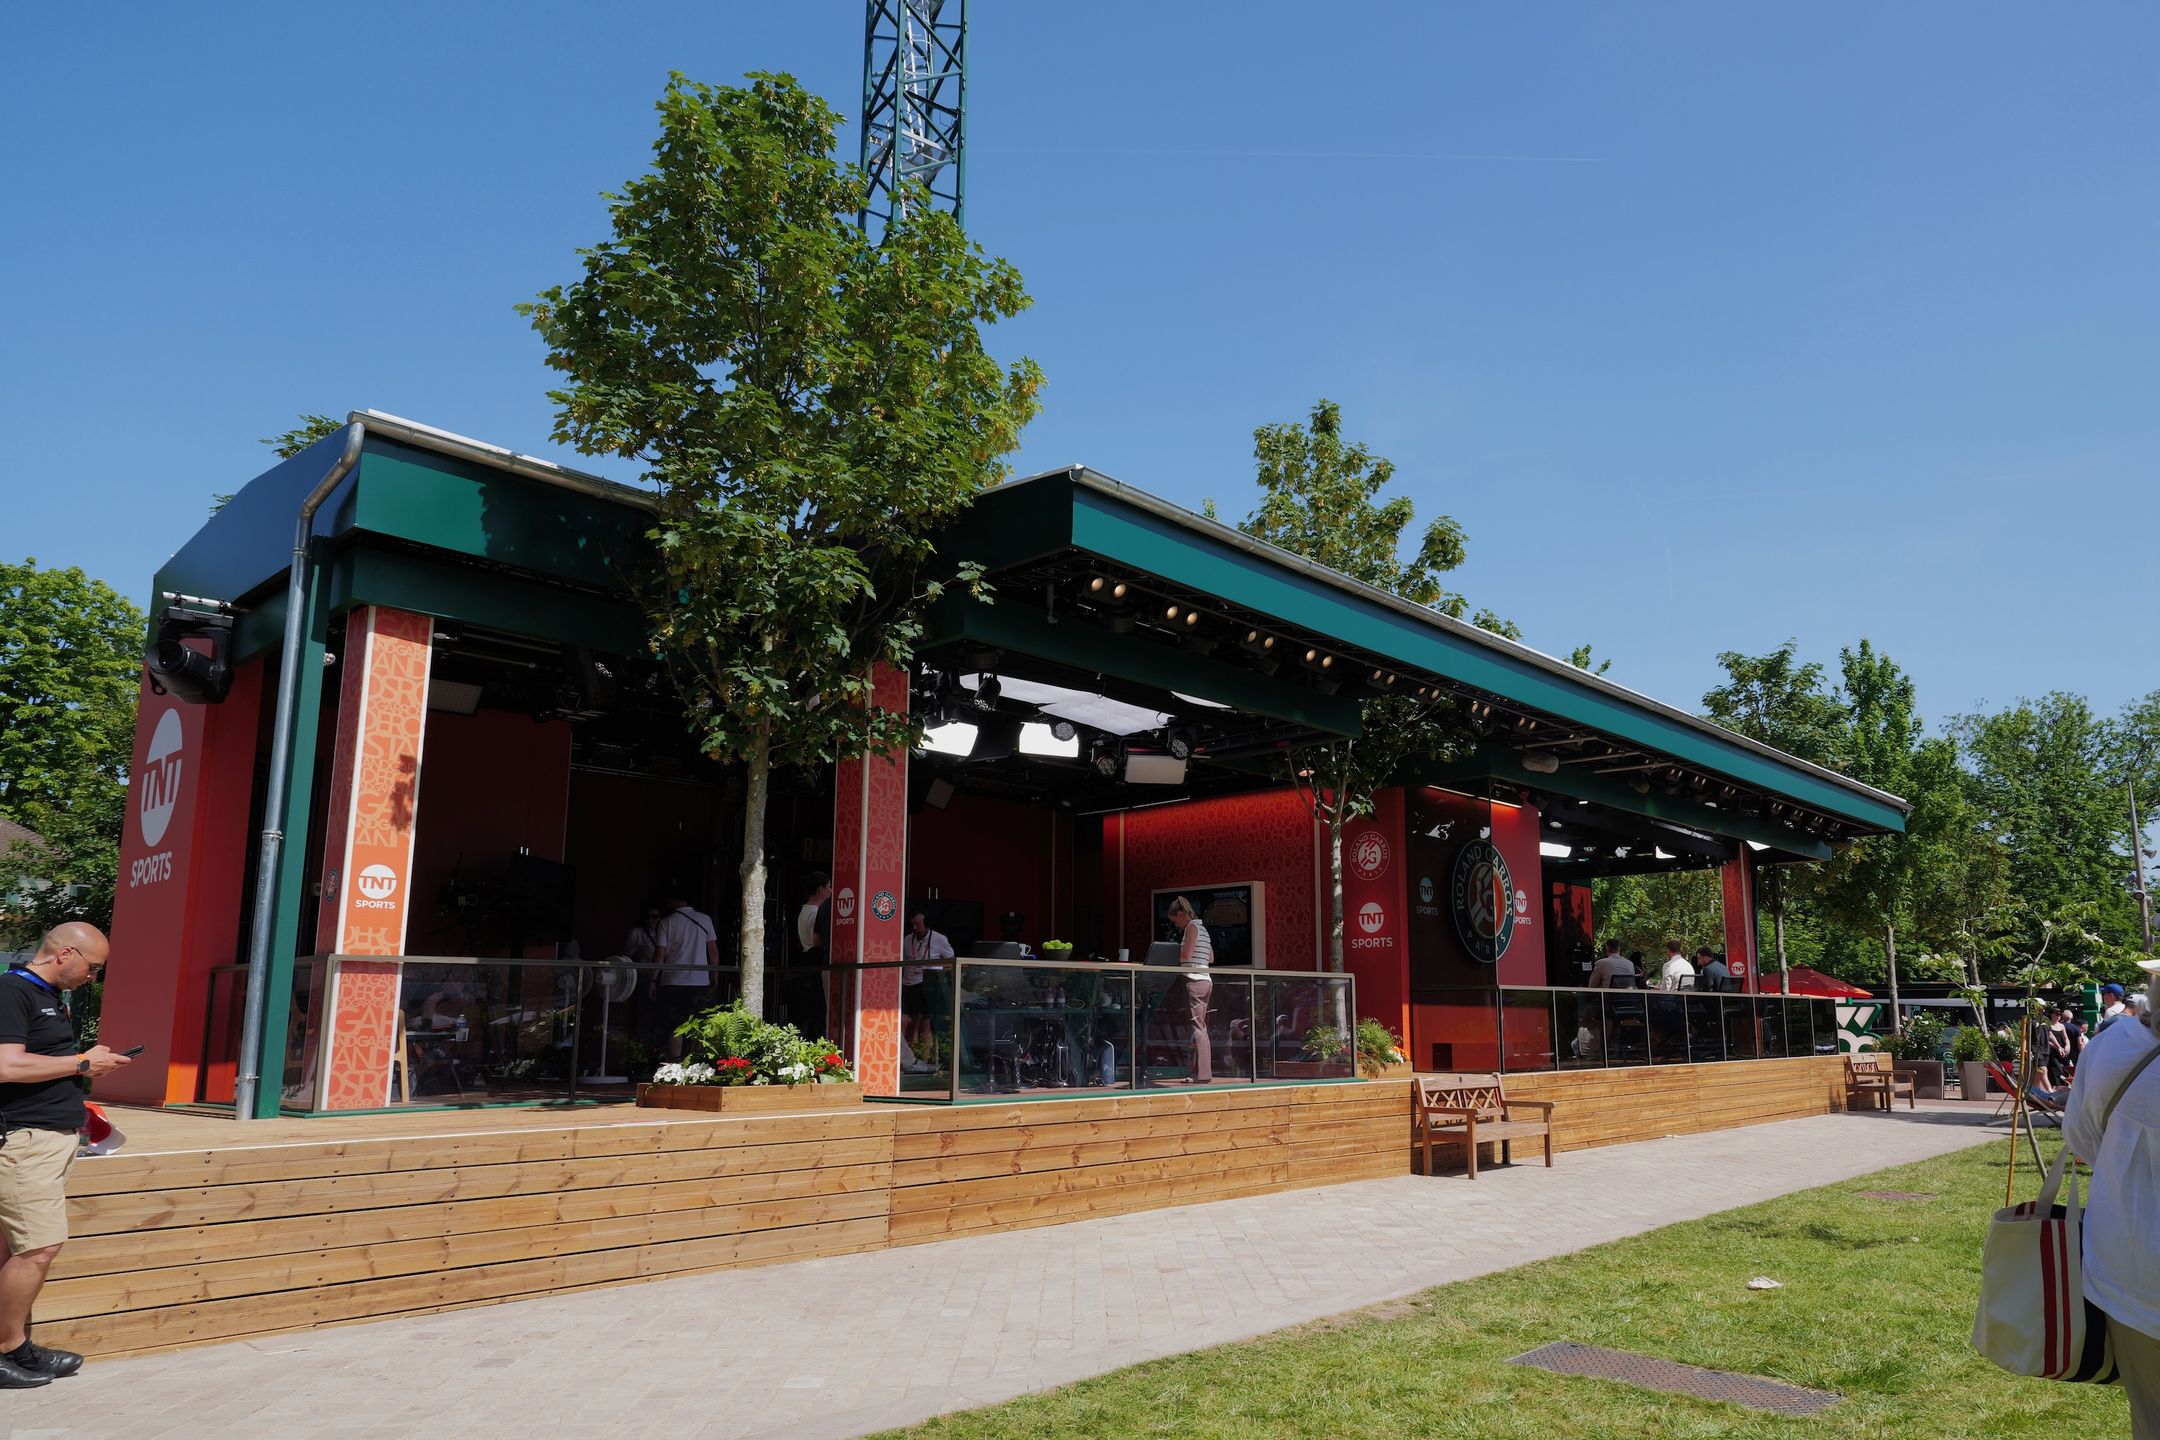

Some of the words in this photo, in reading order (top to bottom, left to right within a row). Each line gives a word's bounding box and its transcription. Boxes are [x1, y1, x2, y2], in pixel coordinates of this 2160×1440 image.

[143, 749, 183, 813] TNT
[1352, 835, 1369, 863] ROLAND
[1370, 834, 1388, 860] GARROS
[130, 851, 173, 888] SPORTS
[359, 875, 396, 890] TNT
[1456, 845, 1482, 910] ROLAND
[1485, 847, 1513, 916] GARROS
[355, 900, 396, 910] SPORTS
[838, 897, 855, 910] TNT
[1416, 906, 1439, 916] SPORTS
[836, 918, 855, 926] SPORTS
[1359, 912, 1384, 925] TNT
[1514, 916, 1532, 925] PORTS
[1351, 937, 1393, 949] SPORTS
